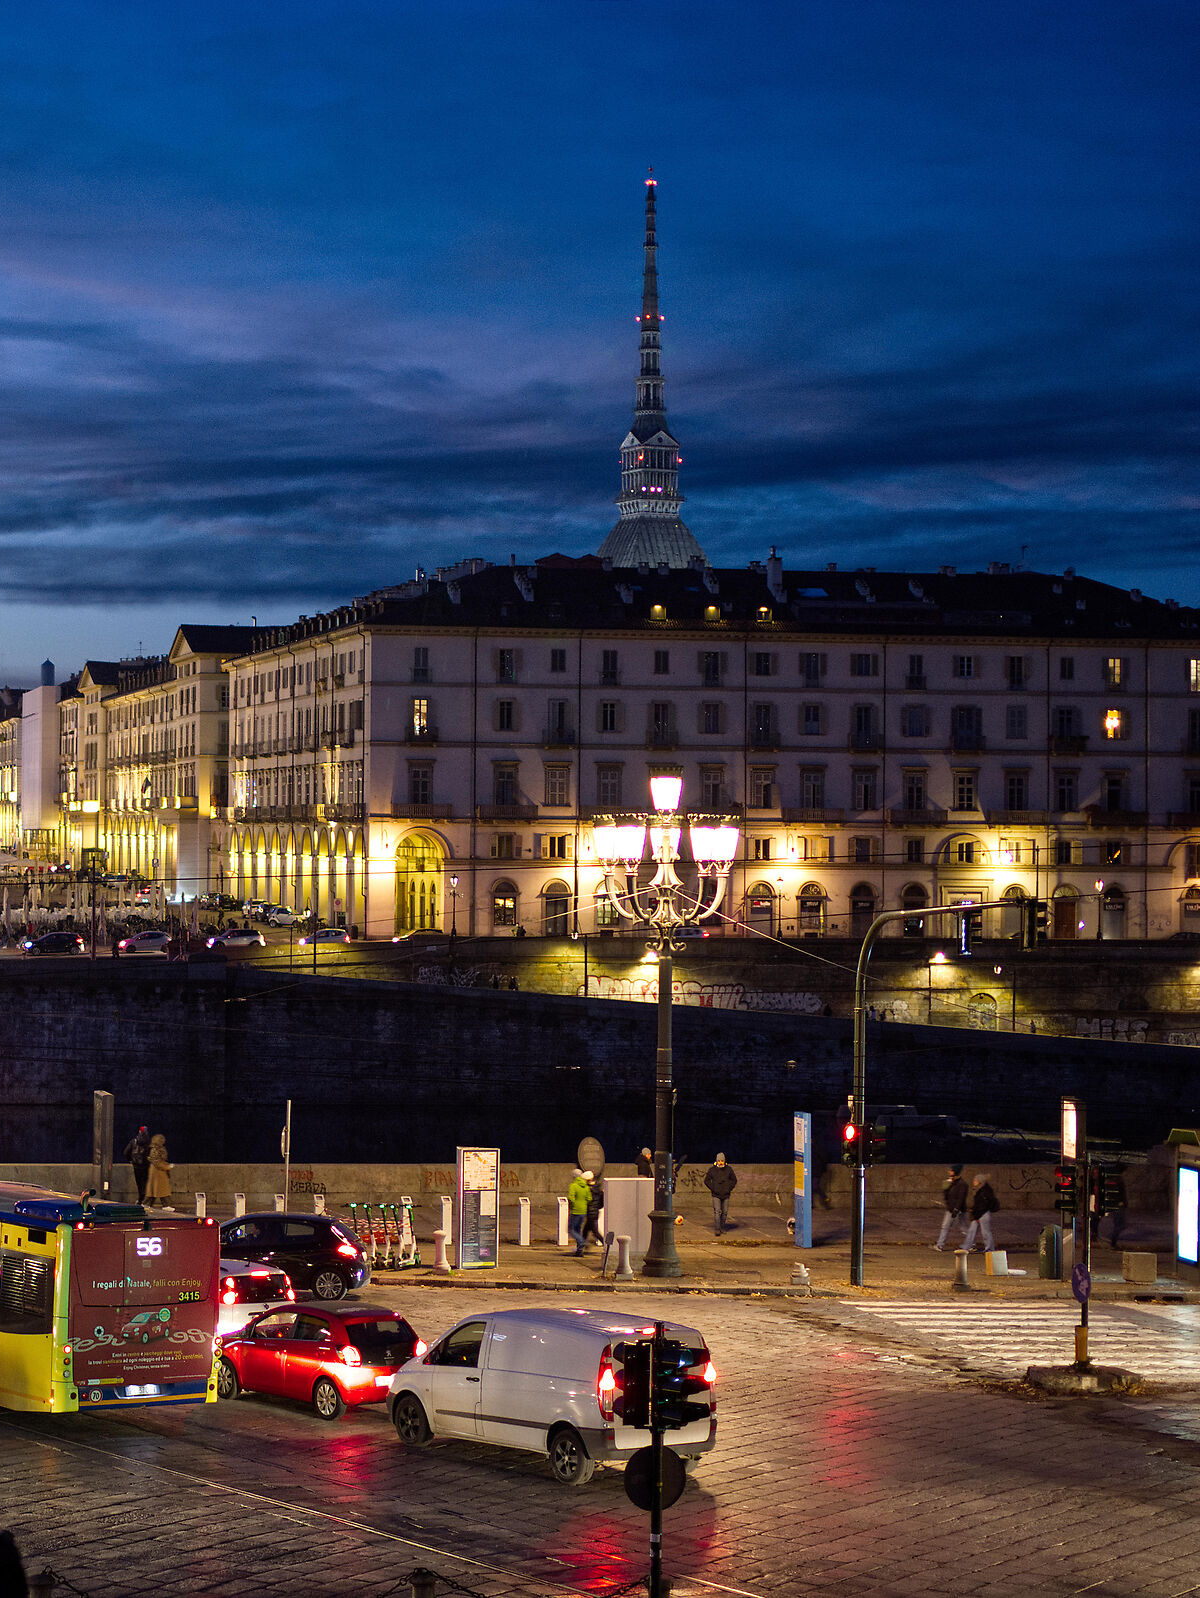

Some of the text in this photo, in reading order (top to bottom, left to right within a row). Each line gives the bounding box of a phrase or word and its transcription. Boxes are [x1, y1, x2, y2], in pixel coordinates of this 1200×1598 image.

[136, 1237, 162, 1256] 56
[97, 1280, 117, 1290] regali
[153, 1279, 166, 1287] falli
[178, 1291, 200, 1301] 3415
[92, 1391, 100, 1400] 70
